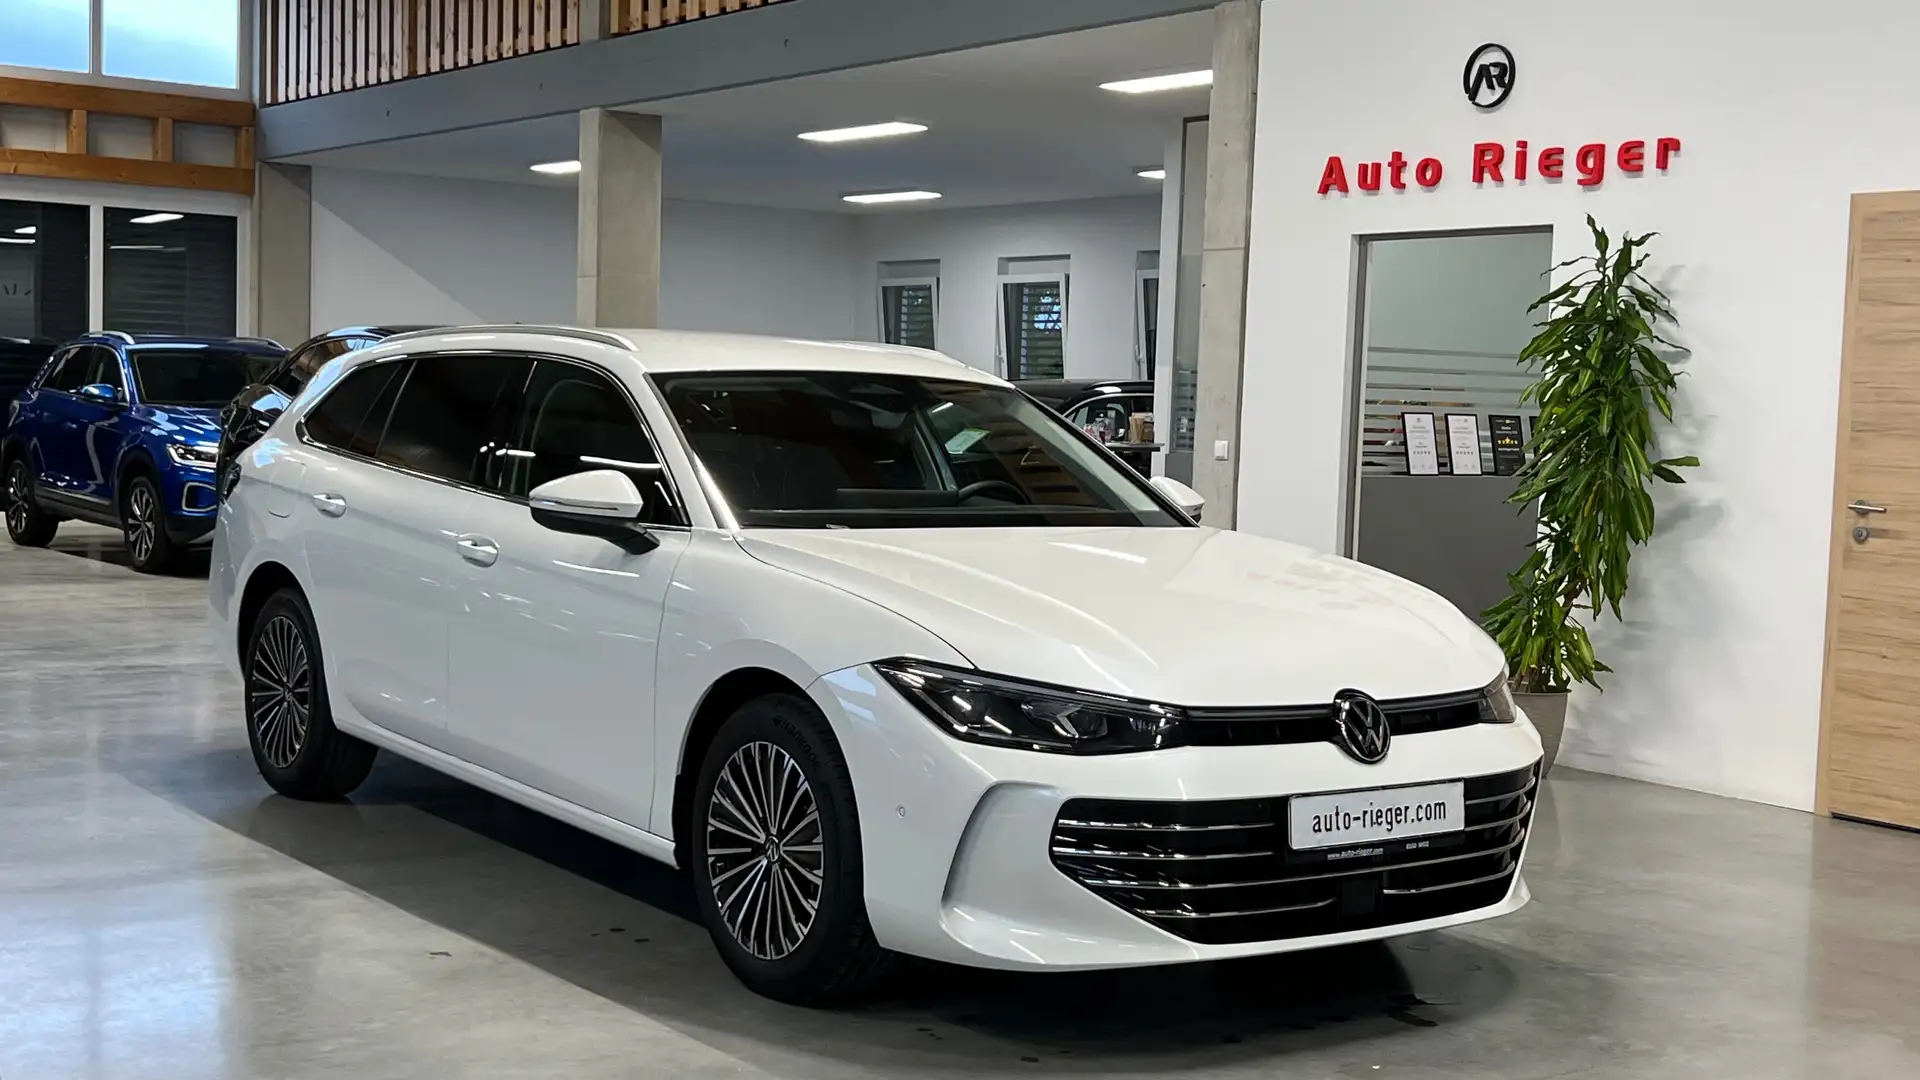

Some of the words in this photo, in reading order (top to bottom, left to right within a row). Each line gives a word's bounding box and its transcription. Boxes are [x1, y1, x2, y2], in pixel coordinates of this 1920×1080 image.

[1317, 150, 1443, 195] Auto
[1472, 137, 1681, 187] Rieger
[1312, 801, 1446, 833] auto-rieger.com
